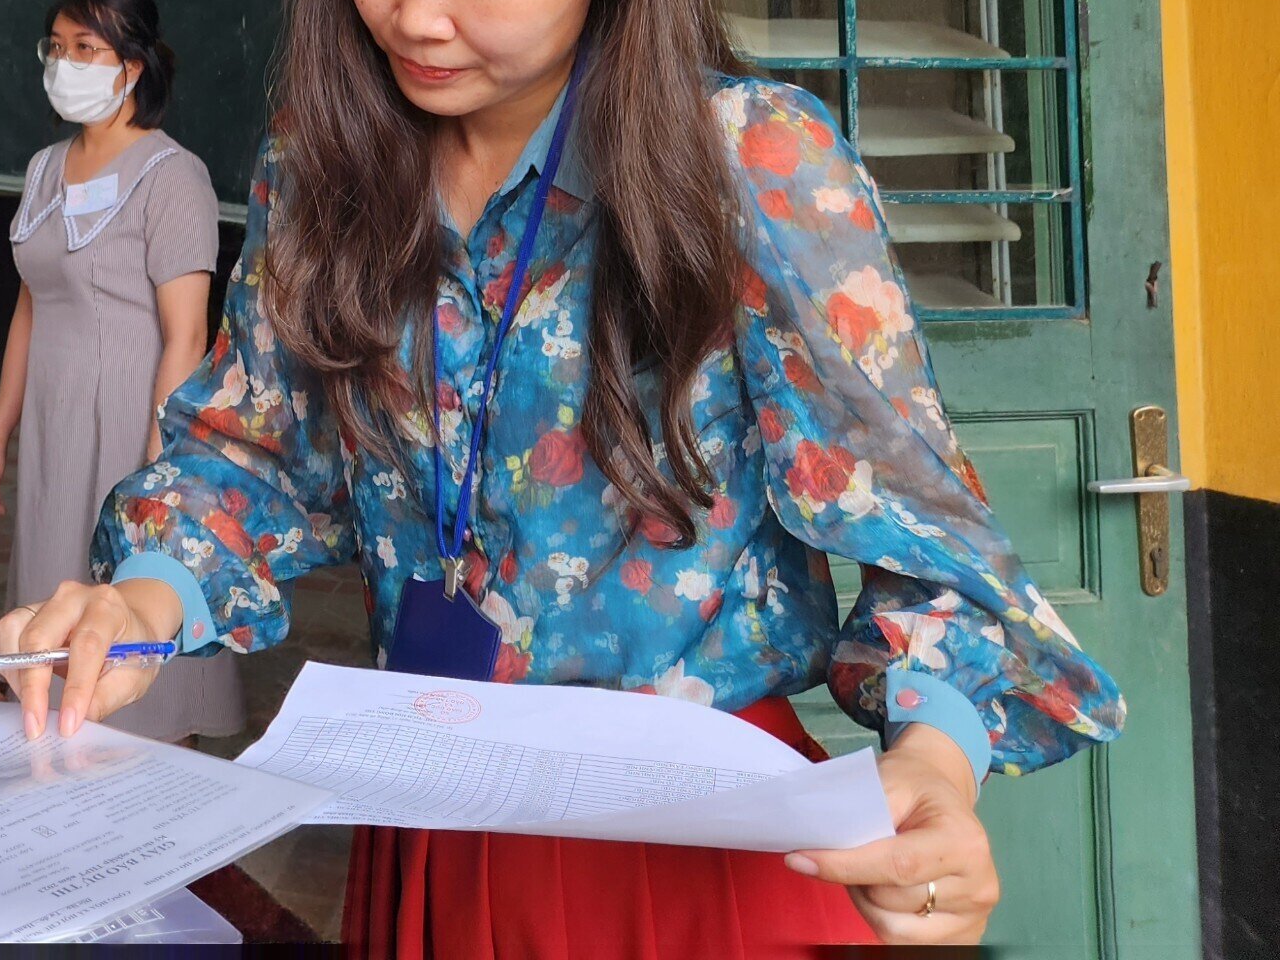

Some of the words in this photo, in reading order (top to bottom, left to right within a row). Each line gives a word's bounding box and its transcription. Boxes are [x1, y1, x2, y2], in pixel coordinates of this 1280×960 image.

[140, 841, 175, 860] GIẤY
[106, 858, 138, 874] BÁO
[81, 873, 105, 887] DỰ
[51, 884, 82, 898] THI
